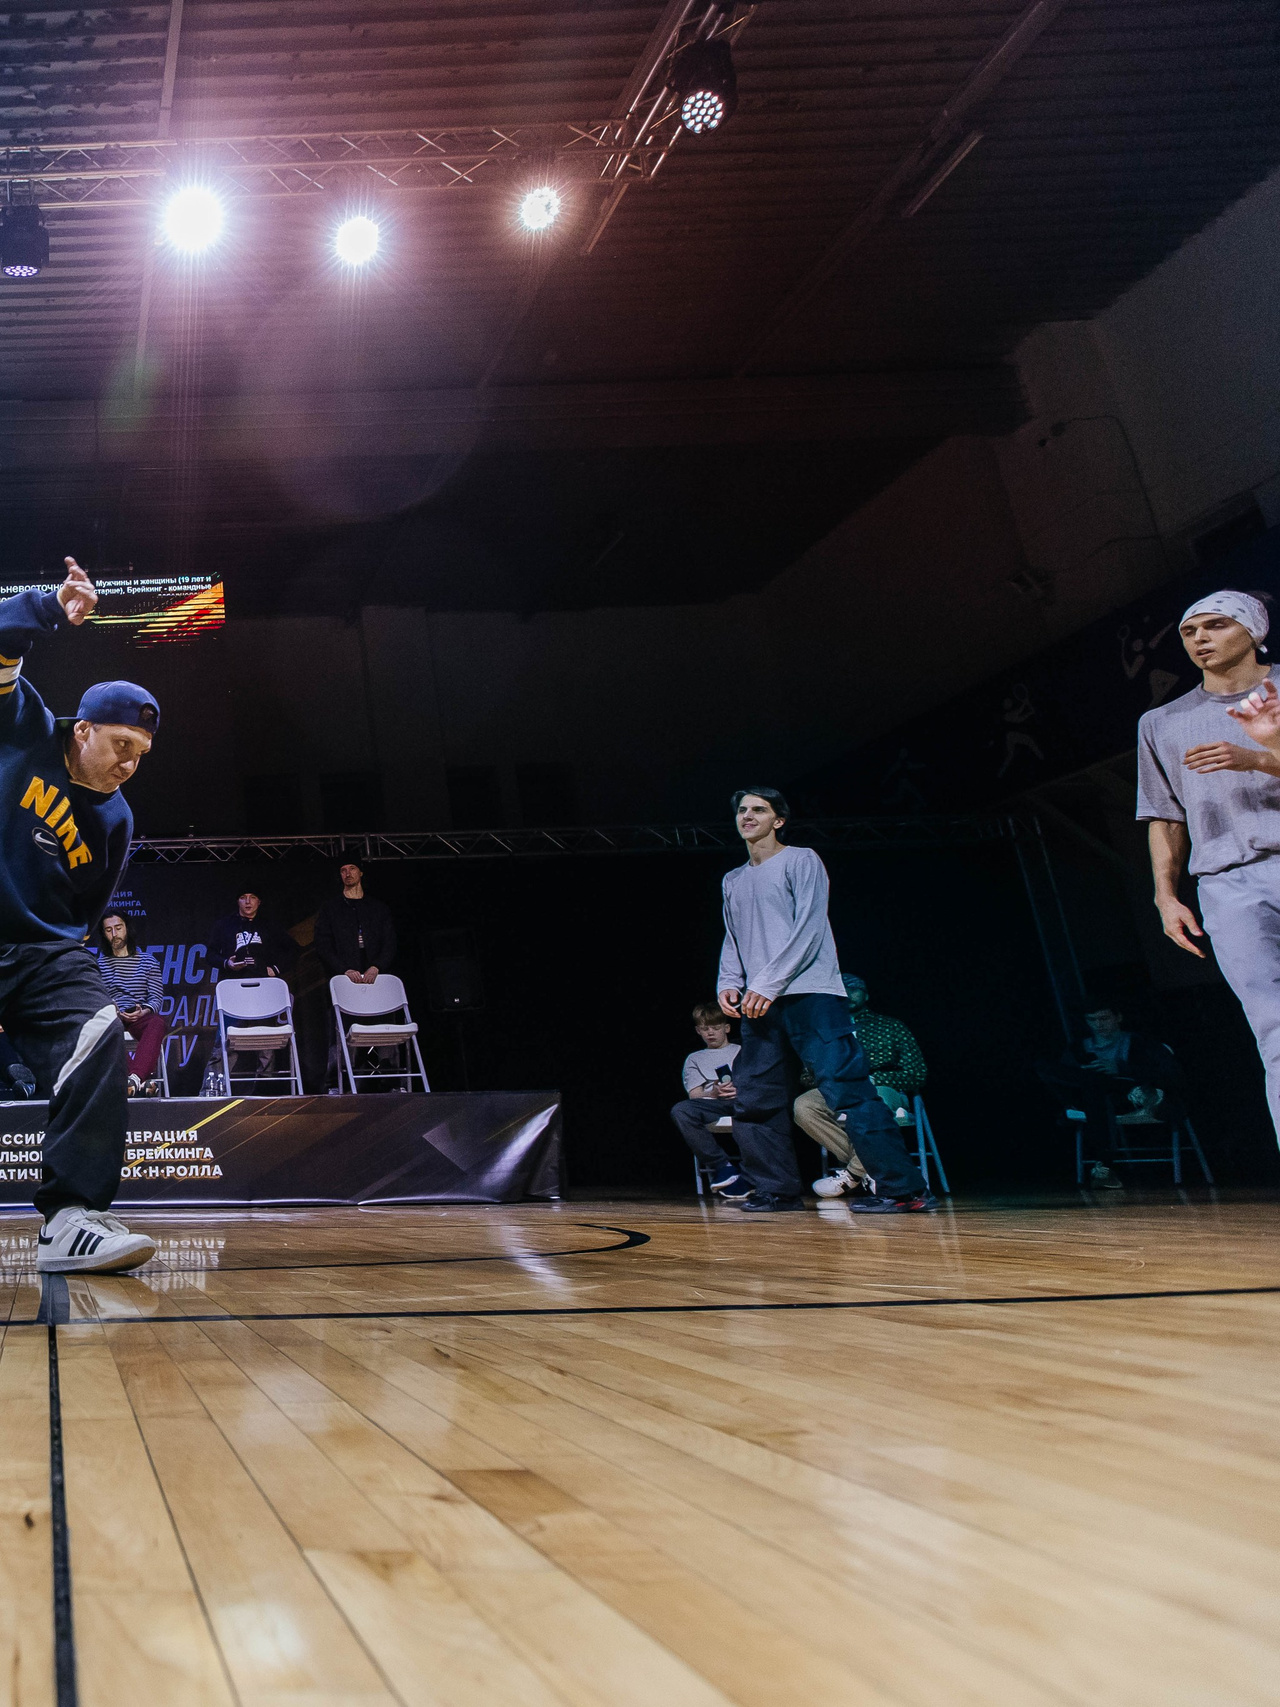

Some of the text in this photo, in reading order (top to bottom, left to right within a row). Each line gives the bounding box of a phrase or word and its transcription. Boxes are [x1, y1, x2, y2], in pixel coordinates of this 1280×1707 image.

[96, 579, 132, 588] Мужчины
[140, 578, 177, 586] женщины
[178, 576, 190, 584] (19
[126, 585, 163, 595] Брейкинг
[20, 776, 93, 870] NIKE
[126, 1146, 215, 1160] БРЕЙКИНГА
